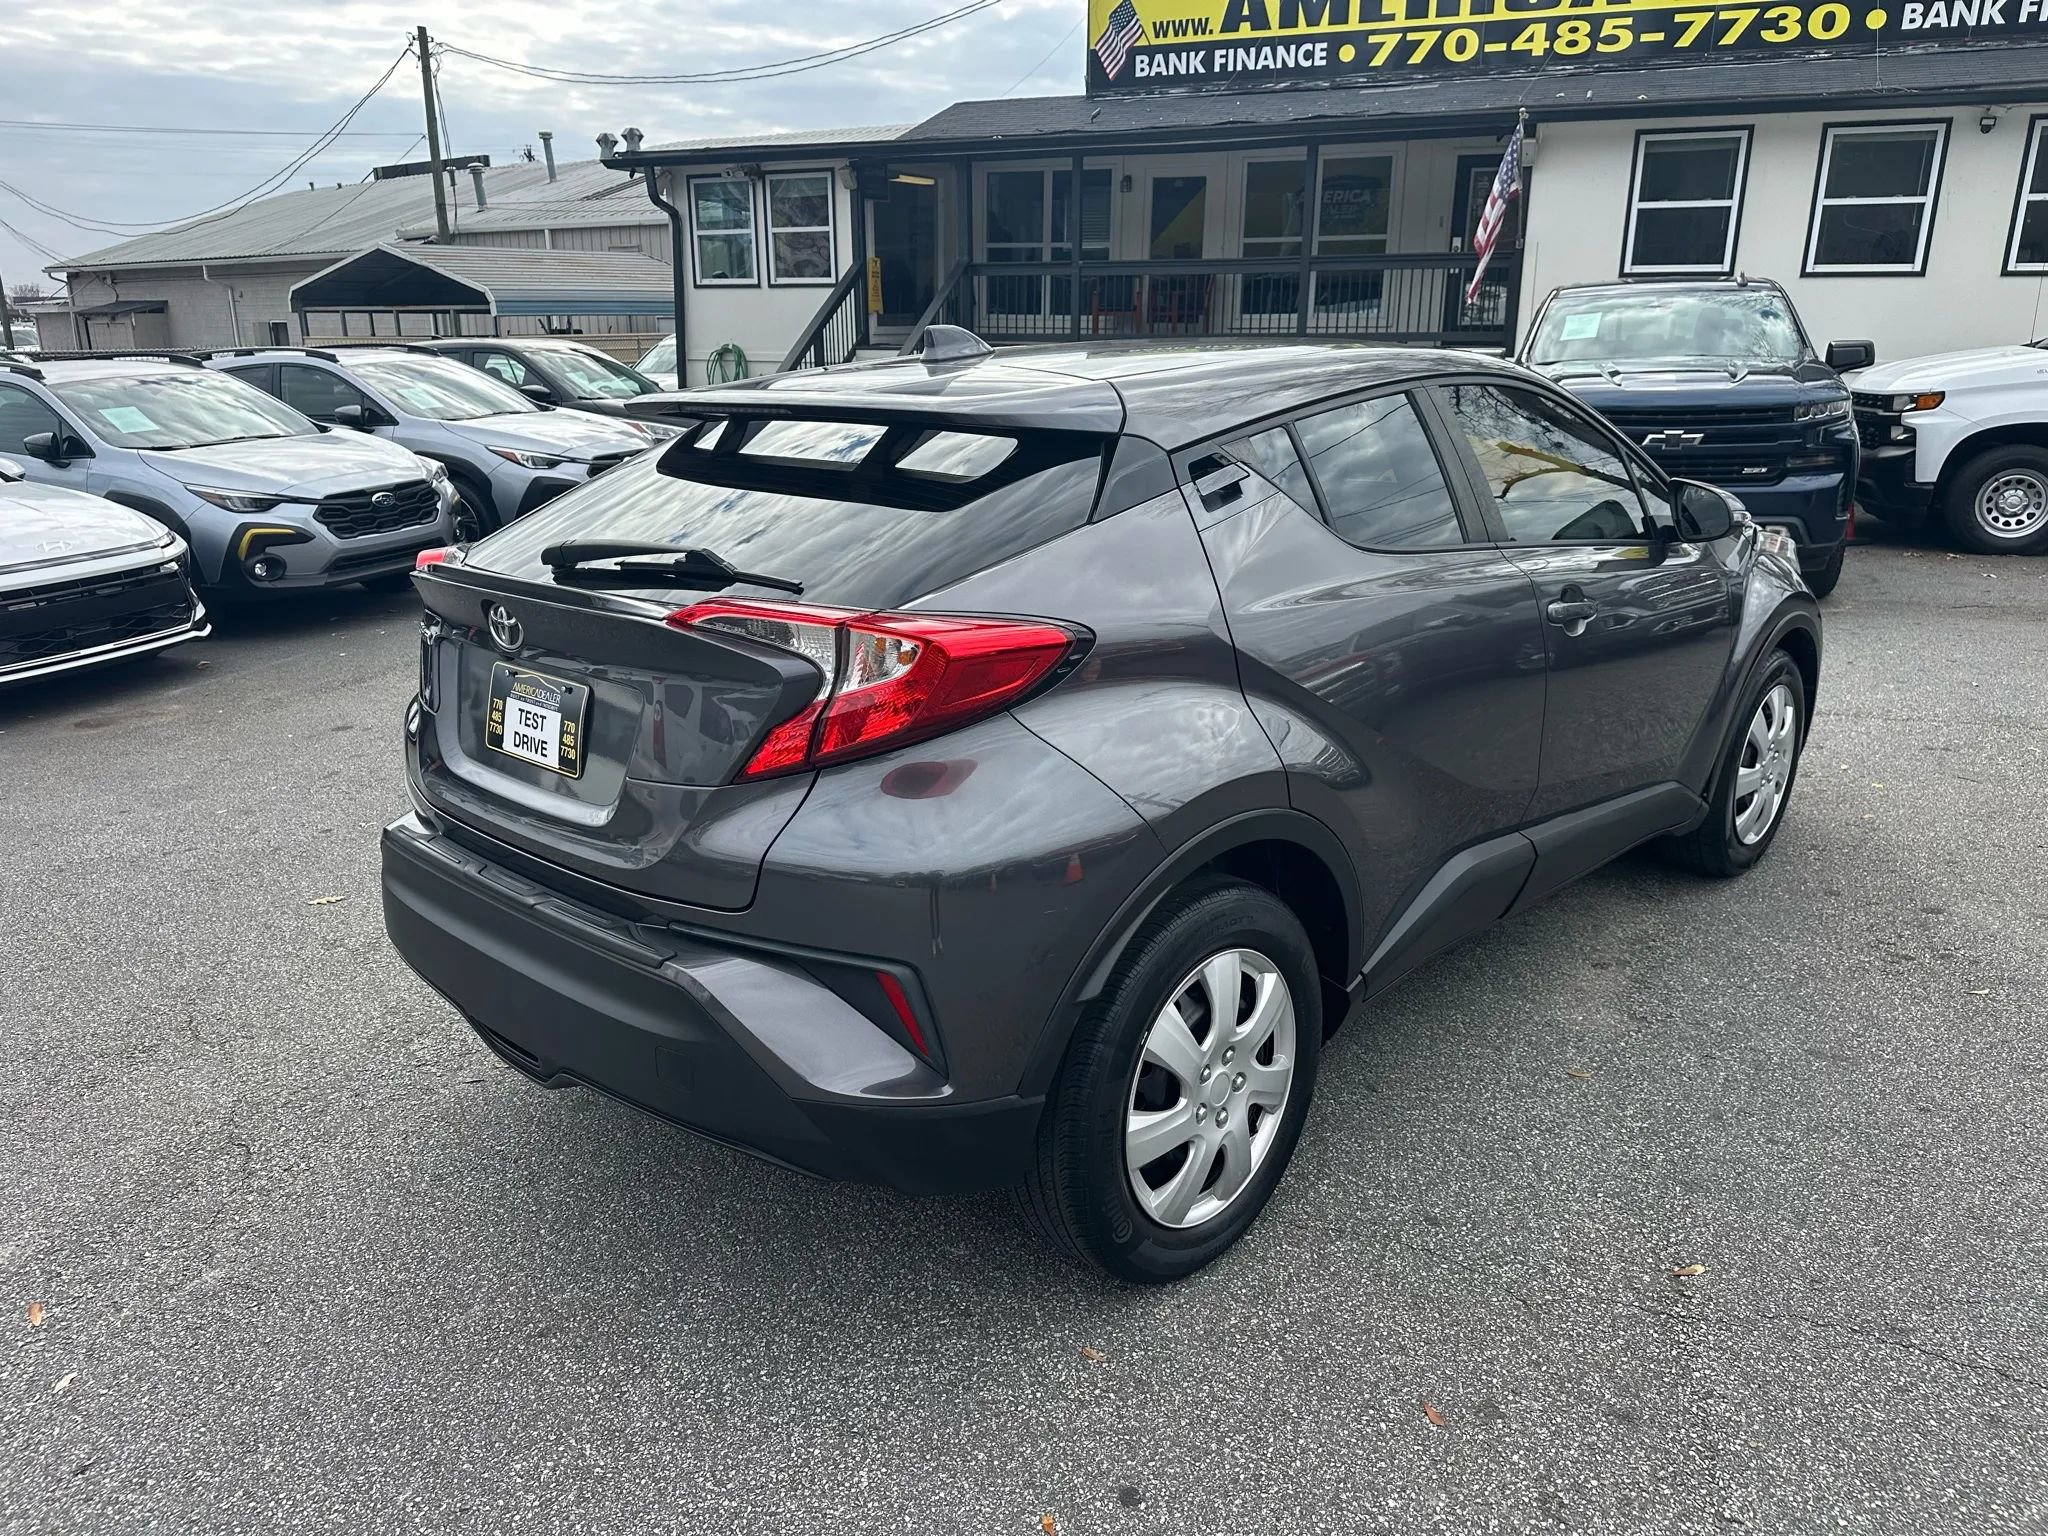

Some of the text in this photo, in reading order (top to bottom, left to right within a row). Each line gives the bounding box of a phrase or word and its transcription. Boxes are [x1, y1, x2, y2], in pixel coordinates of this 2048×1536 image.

[1134, 51, 1211, 78] BANK
[1213, 42, 1328, 73] FINANCE
[1367, 2, 1851, 67] 770-485-7730
[1901, 0, 2006, 30] BANK
[493, 698, 503, 710] 770
[491, 711, 502, 722] 485
[518, 708, 547, 732] TEST
[489, 721, 502, 735] 7730
[563, 720, 576, 734] 770
[513, 731, 548, 758] DRIVE
[562, 734, 575, 746] 485
[560, 745, 576, 760] 7730
